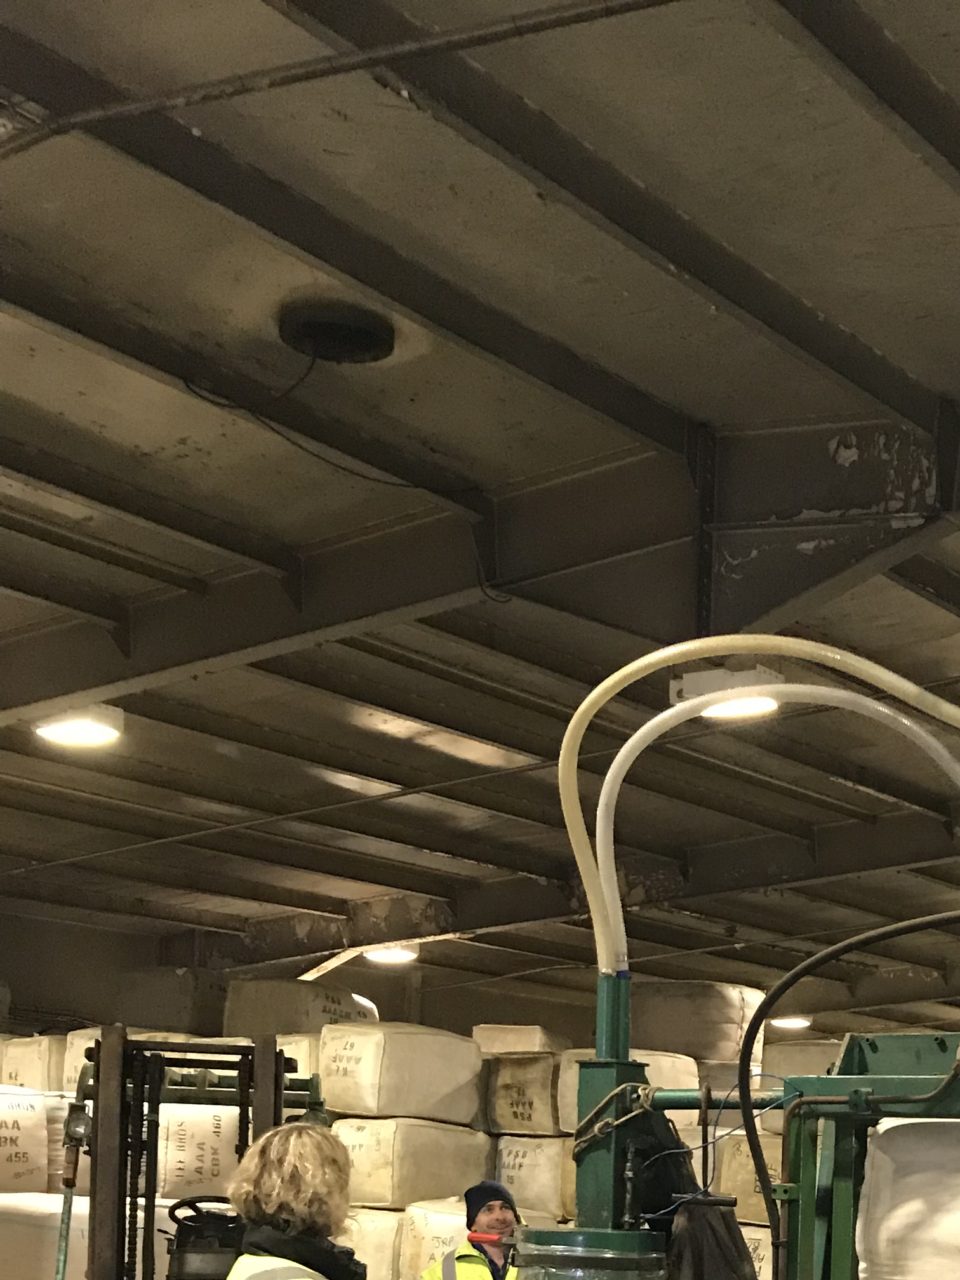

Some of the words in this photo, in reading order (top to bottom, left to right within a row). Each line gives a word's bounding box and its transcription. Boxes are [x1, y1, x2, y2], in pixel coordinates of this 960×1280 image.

[176, 1121, 187, 1152] BROS
[6, 1152, 29, 1163] 455
[194, 1141, 206, 1176] AAA
[210, 1145, 220, 1178] CBK
